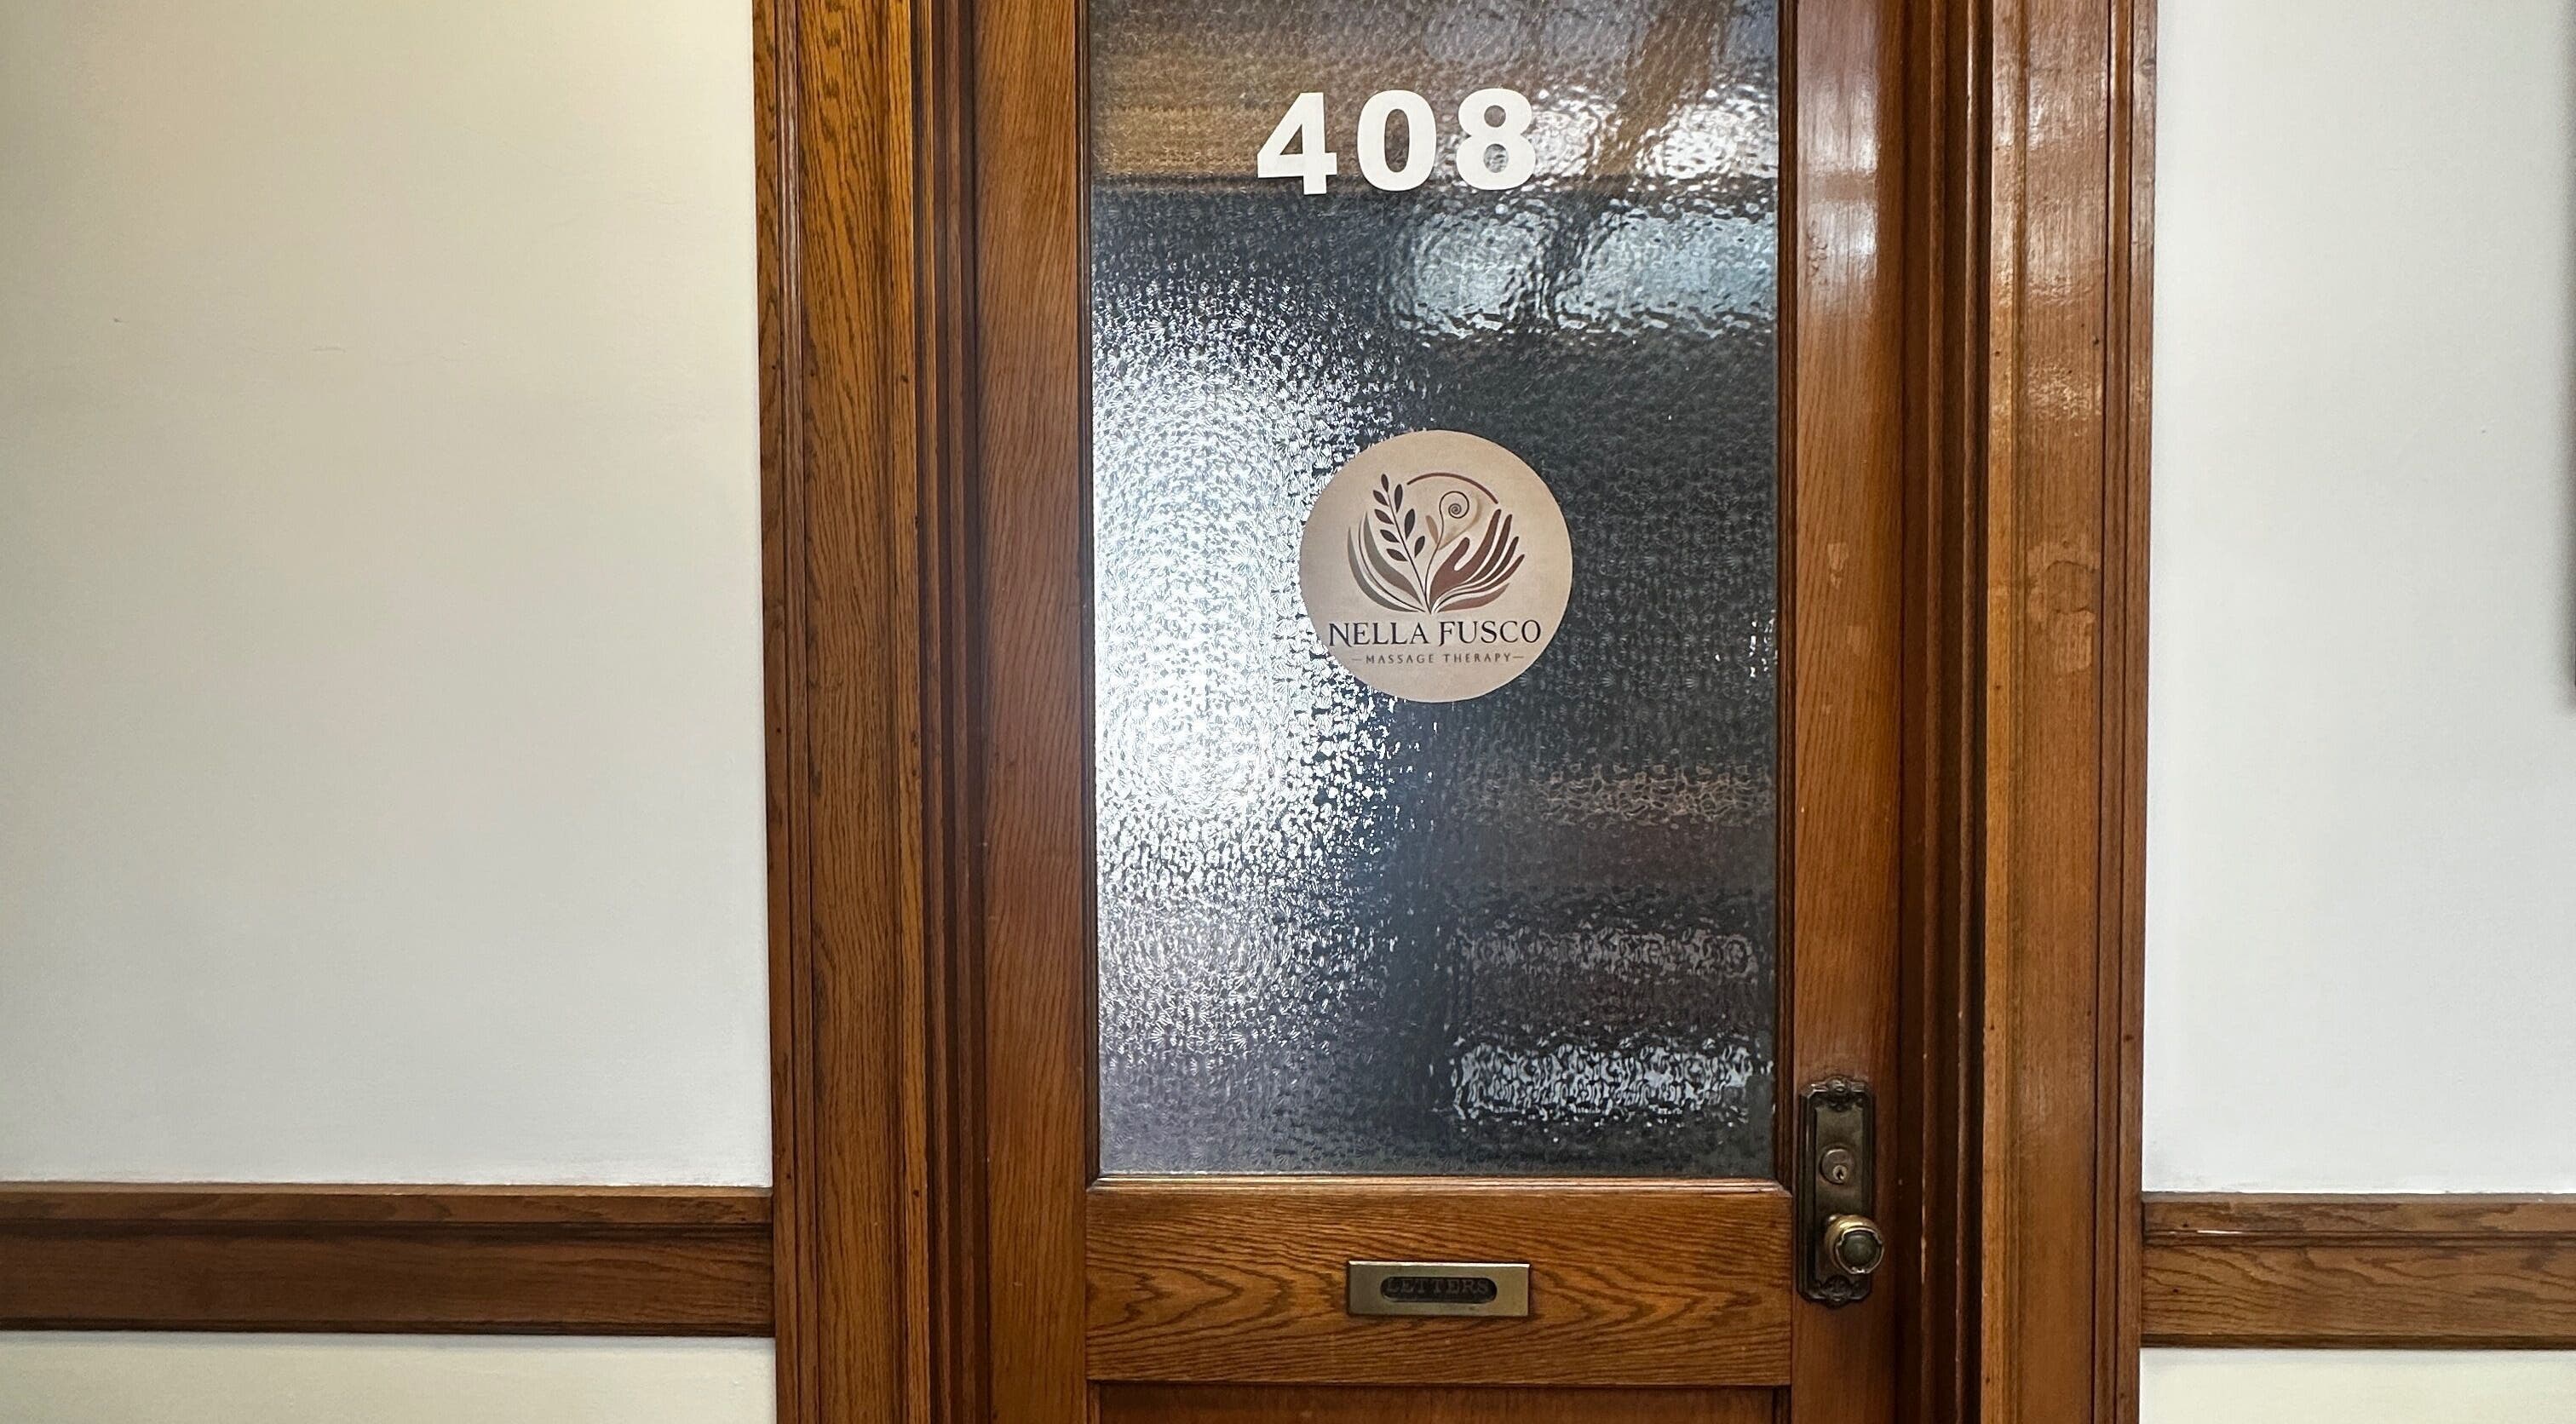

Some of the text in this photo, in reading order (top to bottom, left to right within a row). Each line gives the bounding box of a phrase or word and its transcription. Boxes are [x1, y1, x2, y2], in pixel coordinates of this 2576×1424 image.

[1256, 88, 1536, 195] 408
[1328, 619, 1541, 647] NELLA FUSCO
[1366, 652, 1511, 663] MASSAGE THERAPY
[1386, 1277, 1489, 1295] LETTERS
